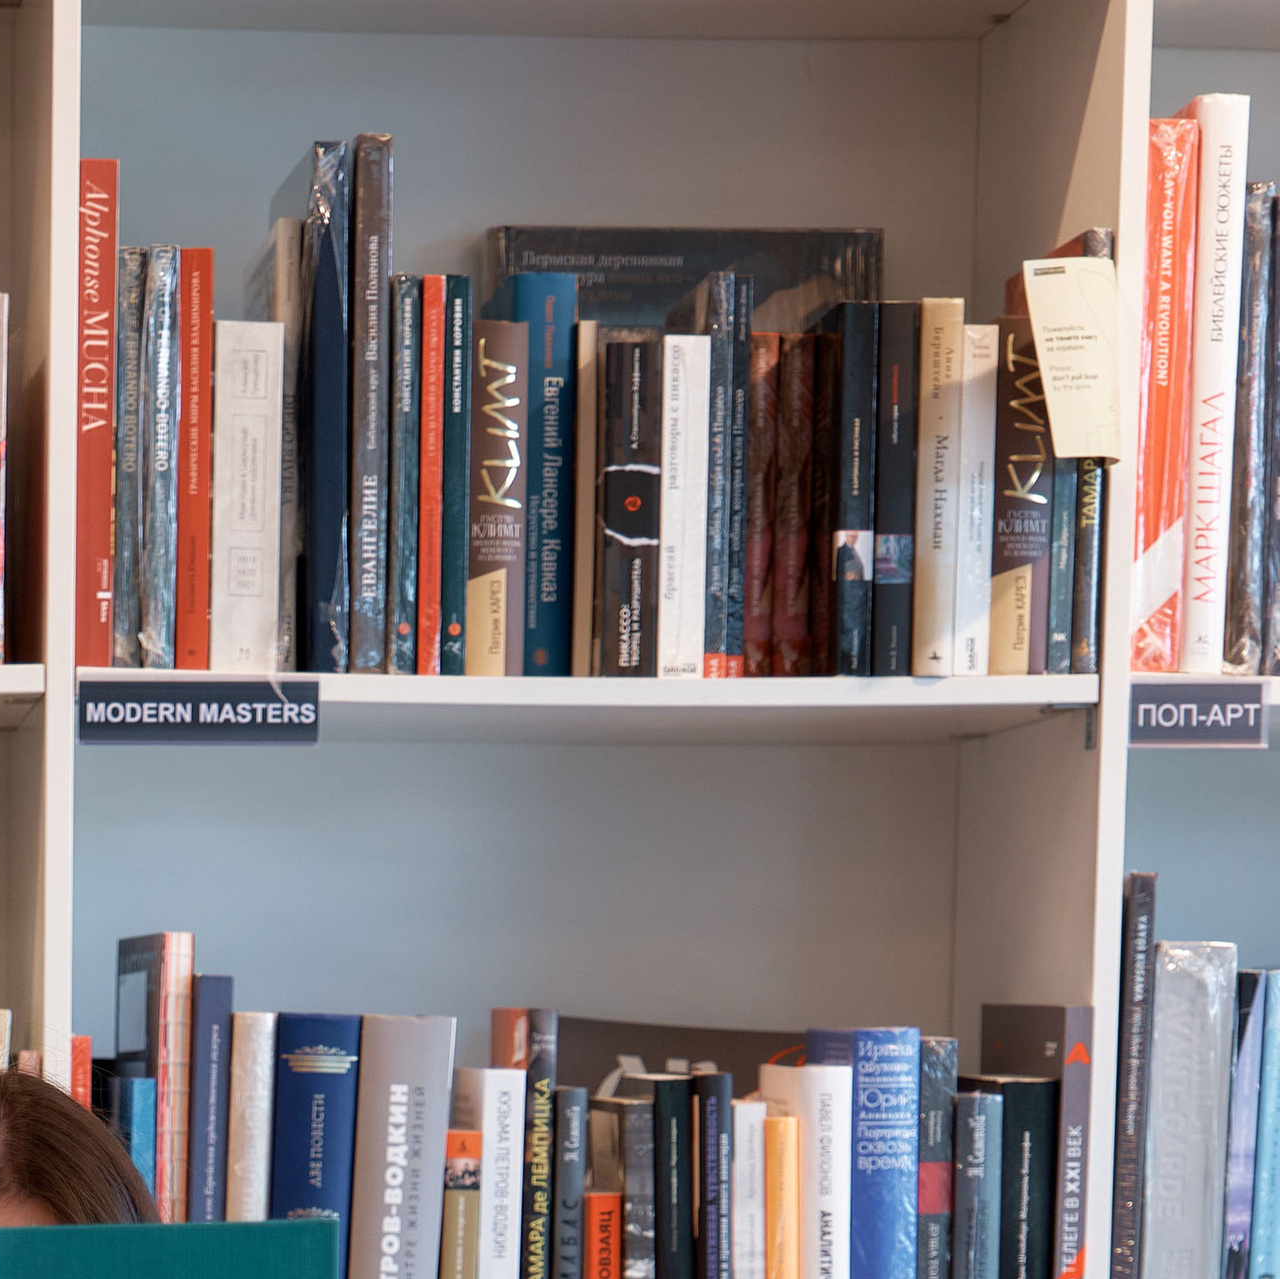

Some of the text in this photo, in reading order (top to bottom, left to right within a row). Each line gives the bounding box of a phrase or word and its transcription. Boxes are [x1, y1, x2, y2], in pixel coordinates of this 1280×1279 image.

[366, 235, 380, 300] Поленова
[1210, 145, 1233, 342] БИБЛЕЙСКИЕ СЮЖЕТЫ
[80, 180, 110, 432] Alphonse MUCHA
[365, 305, 378, 361] Василия
[452, 298, 463, 346] КОРОВИН
[1157, 236, 1174, 386] WANT REVOLUTION?
[189, 347, 200, 392] ВАСИЛИЯ
[944, 347, 954, 379] Анна
[155, 330, 170, 471] FERNANDO BOTERO
[477, 339, 522, 508] KLIMT
[125, 415, 139, 472] BOTERO
[539, 376, 564, 603] Евгений Лансере. Кавказ
[1192, 393, 1224, 604] МАРК ШАГАЛ
[362, 475, 377, 599] ЕВАНГЕЛИЕ
[931, 488, 948, 550] Нахман
[631, 632, 641, 667] ТВОРЕЦ
[86, 701, 316, 724] MODERN MASTERS
[1138, 703, 1261, 728] ПОП-АРТ
[411, 1086, 426, 1159] ЖИЗНЕЙ
[858, 1088, 916, 1111] Юрий
[531, 1078, 552, 1188] ЛЕМПИЦКА
[858, 1142, 913, 1155] сквозь
[1066, 1125, 1082, 1157] ВЕК
[858, 1156, 915, 1174] время
[533, 1191, 548, 1214] де
